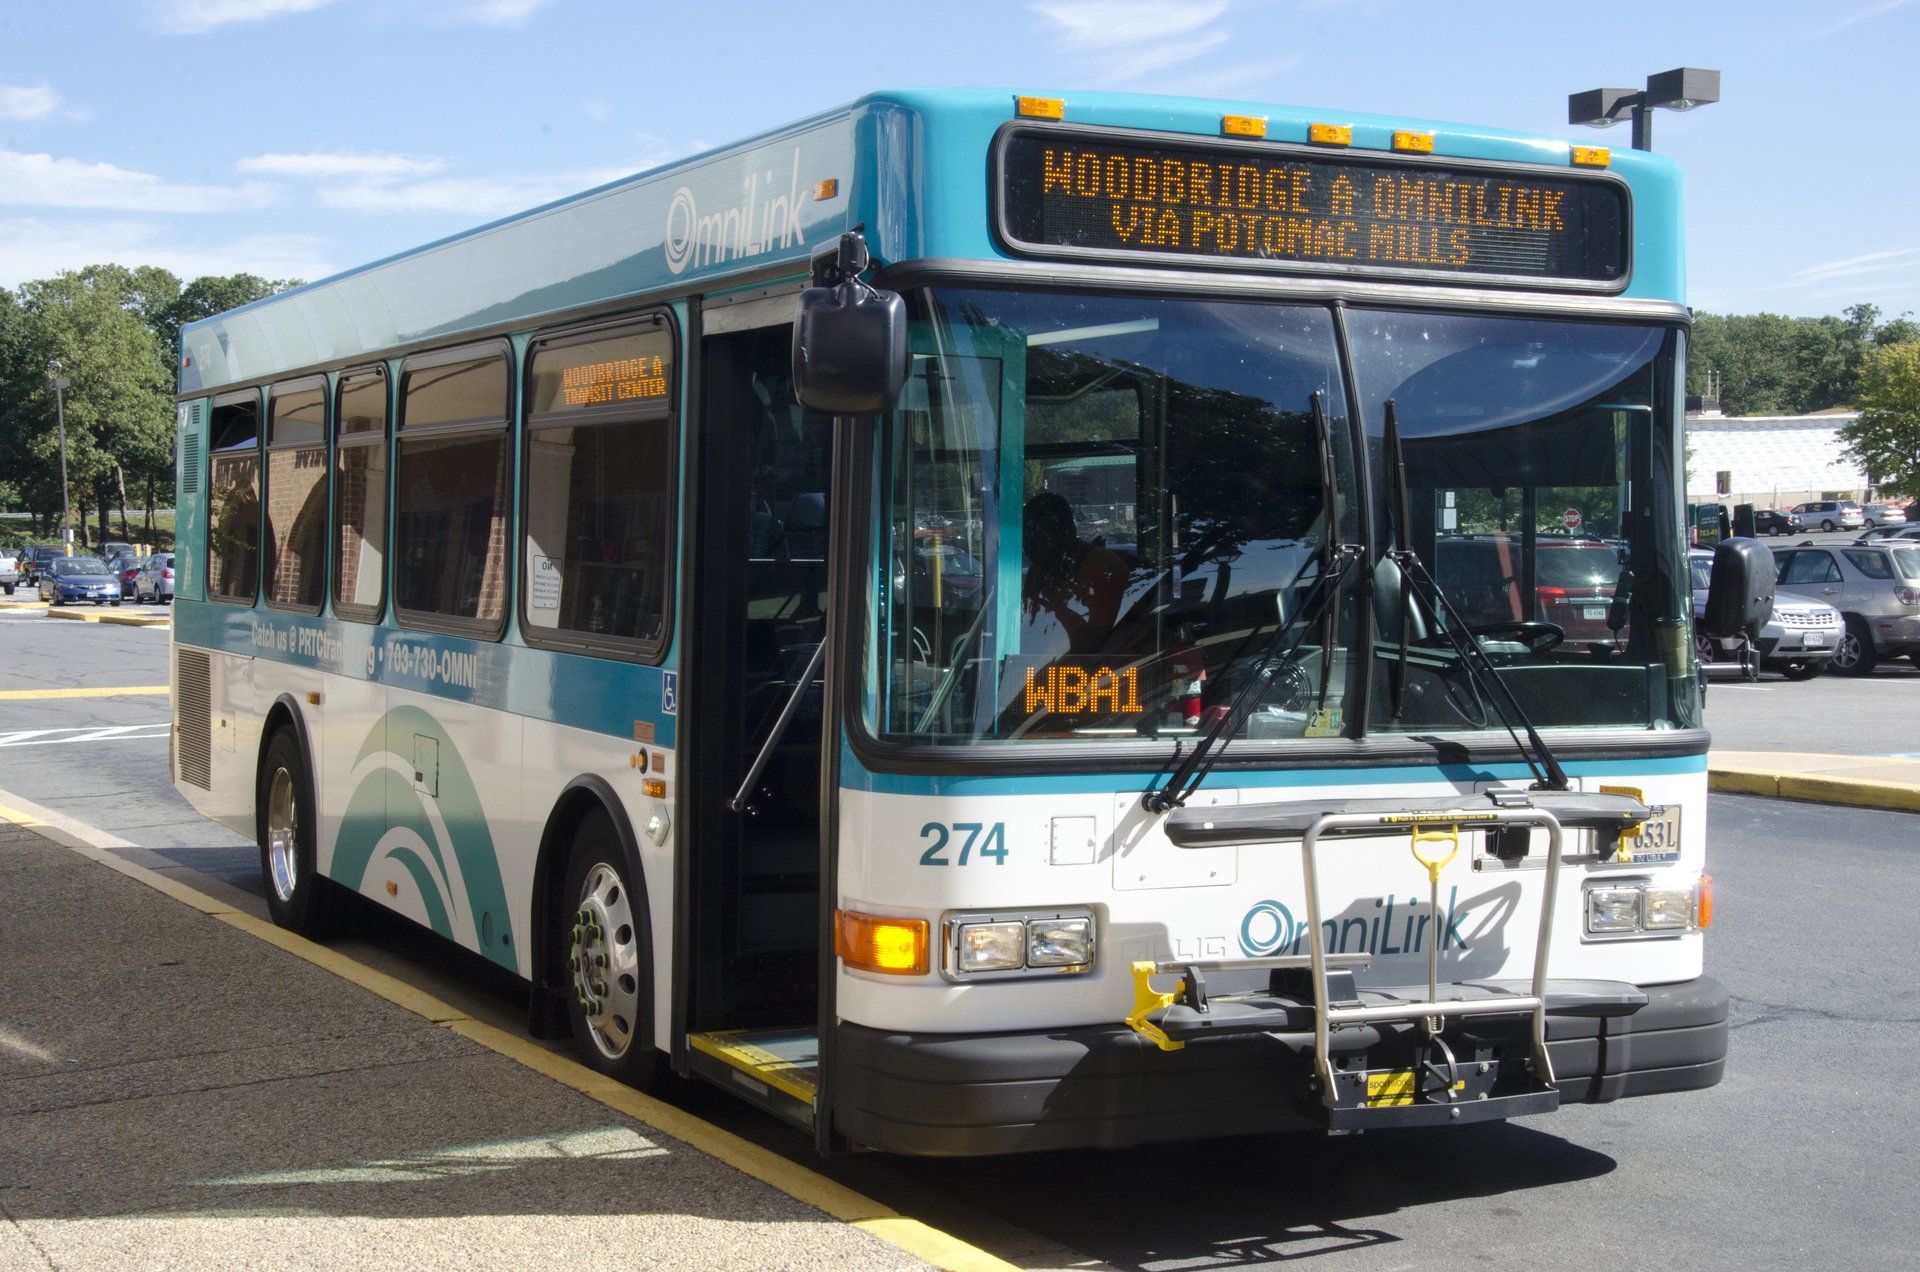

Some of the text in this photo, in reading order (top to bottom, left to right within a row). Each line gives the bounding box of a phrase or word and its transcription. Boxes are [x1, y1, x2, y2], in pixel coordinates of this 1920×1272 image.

[664, 147, 808, 274] OmniLink
[1044, 150, 1310, 212] WOODBRIDGE
[1373, 177, 1564, 230] OMNILINK
[1111, 204, 1471, 265] VIA POTOMAC MILLS
[563, 355, 663, 387] WOODBRIDGE A
[563, 377, 666, 405] TRANSIT CENTER
[1564, 514, 1579, 523] STOP
[251, 620, 477, 688] Catch us @ PRTCtransit.org 703-730-OMNI
[1026, 666, 1143, 714] WBA1
[919, 821, 1009, 866] 274
[1237, 885, 1470, 958] OmniLink
[1369, 1077, 1413, 1090] sportworks
